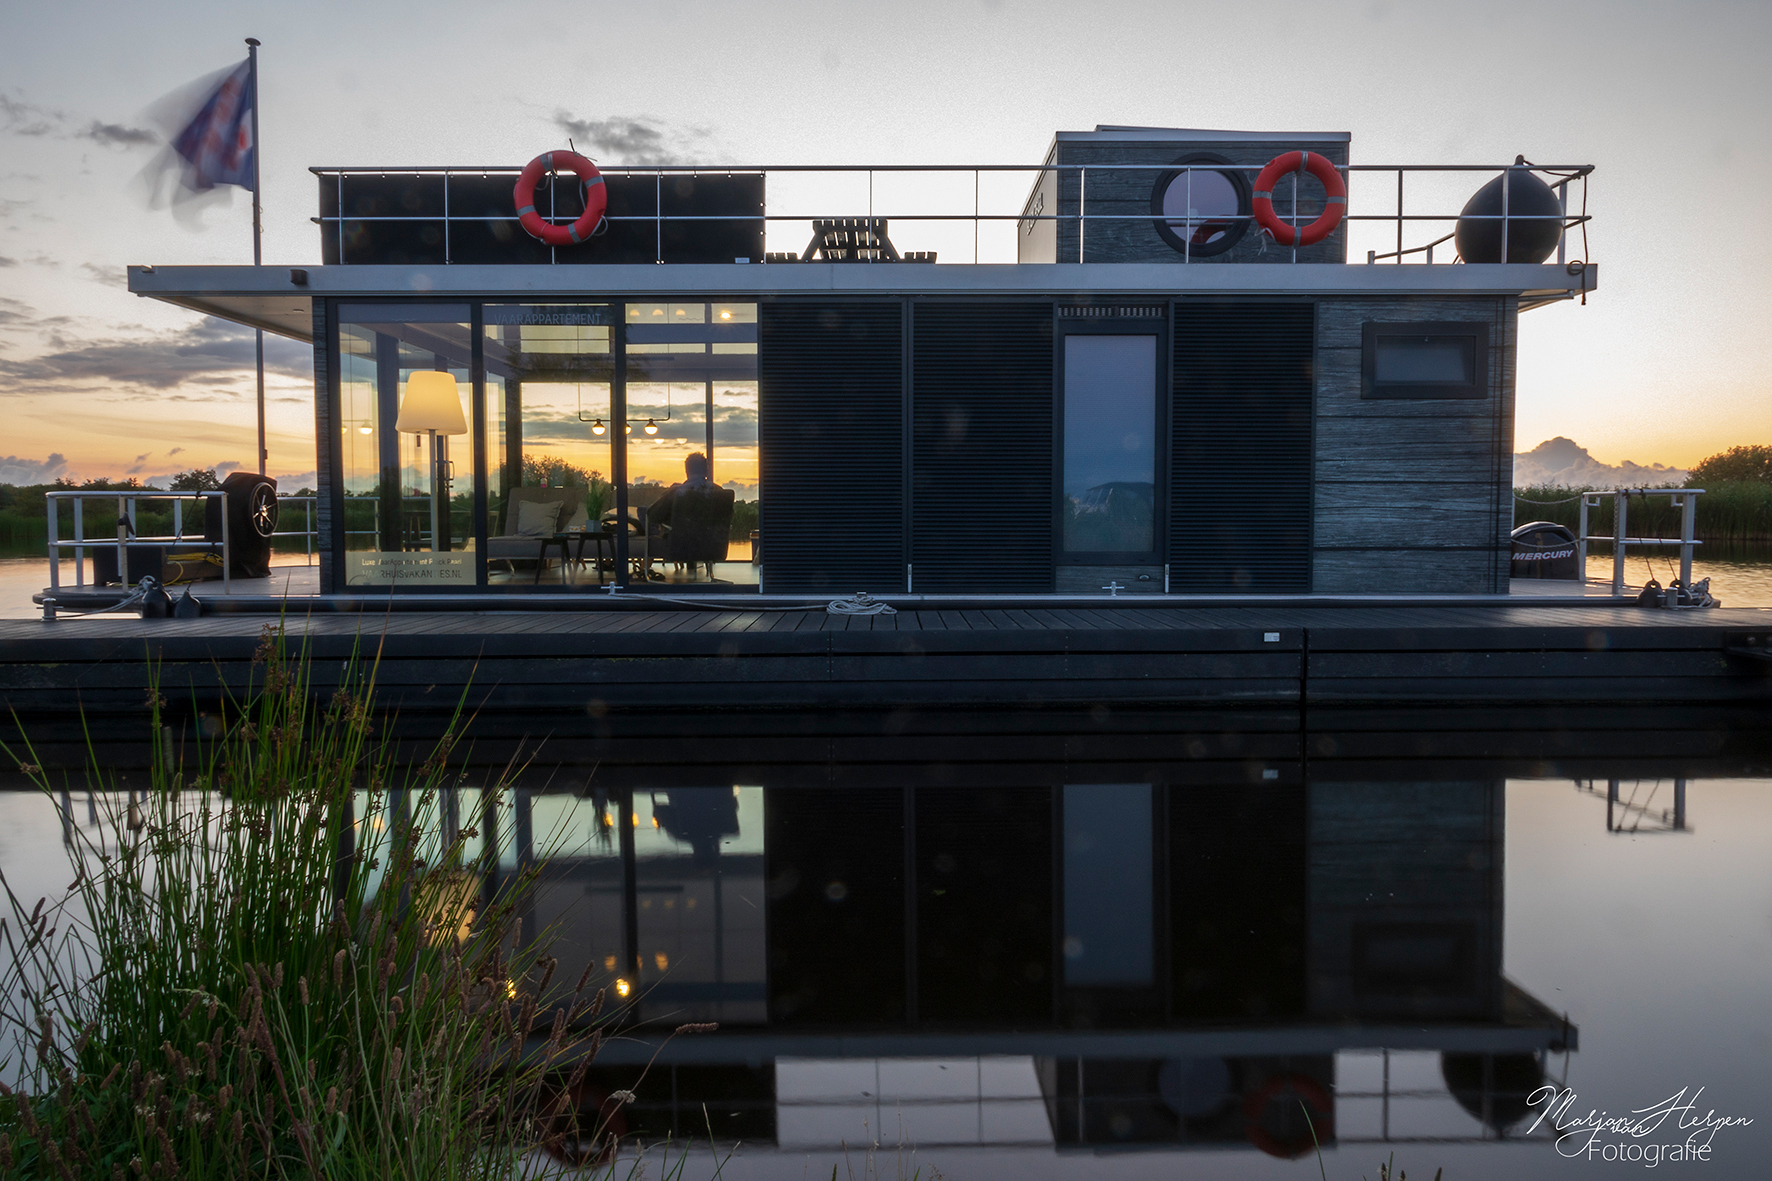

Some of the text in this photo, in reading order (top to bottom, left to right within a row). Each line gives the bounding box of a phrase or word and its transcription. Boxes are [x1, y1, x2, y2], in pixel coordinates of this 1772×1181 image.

[495, 313, 602, 325] VAARAPPARTEMENT
[1512, 549, 1574, 561] MERCURY
[361, 558, 376, 566] Luxe
[362, 569, 462, 578] VARHUISVAKANES.NL
